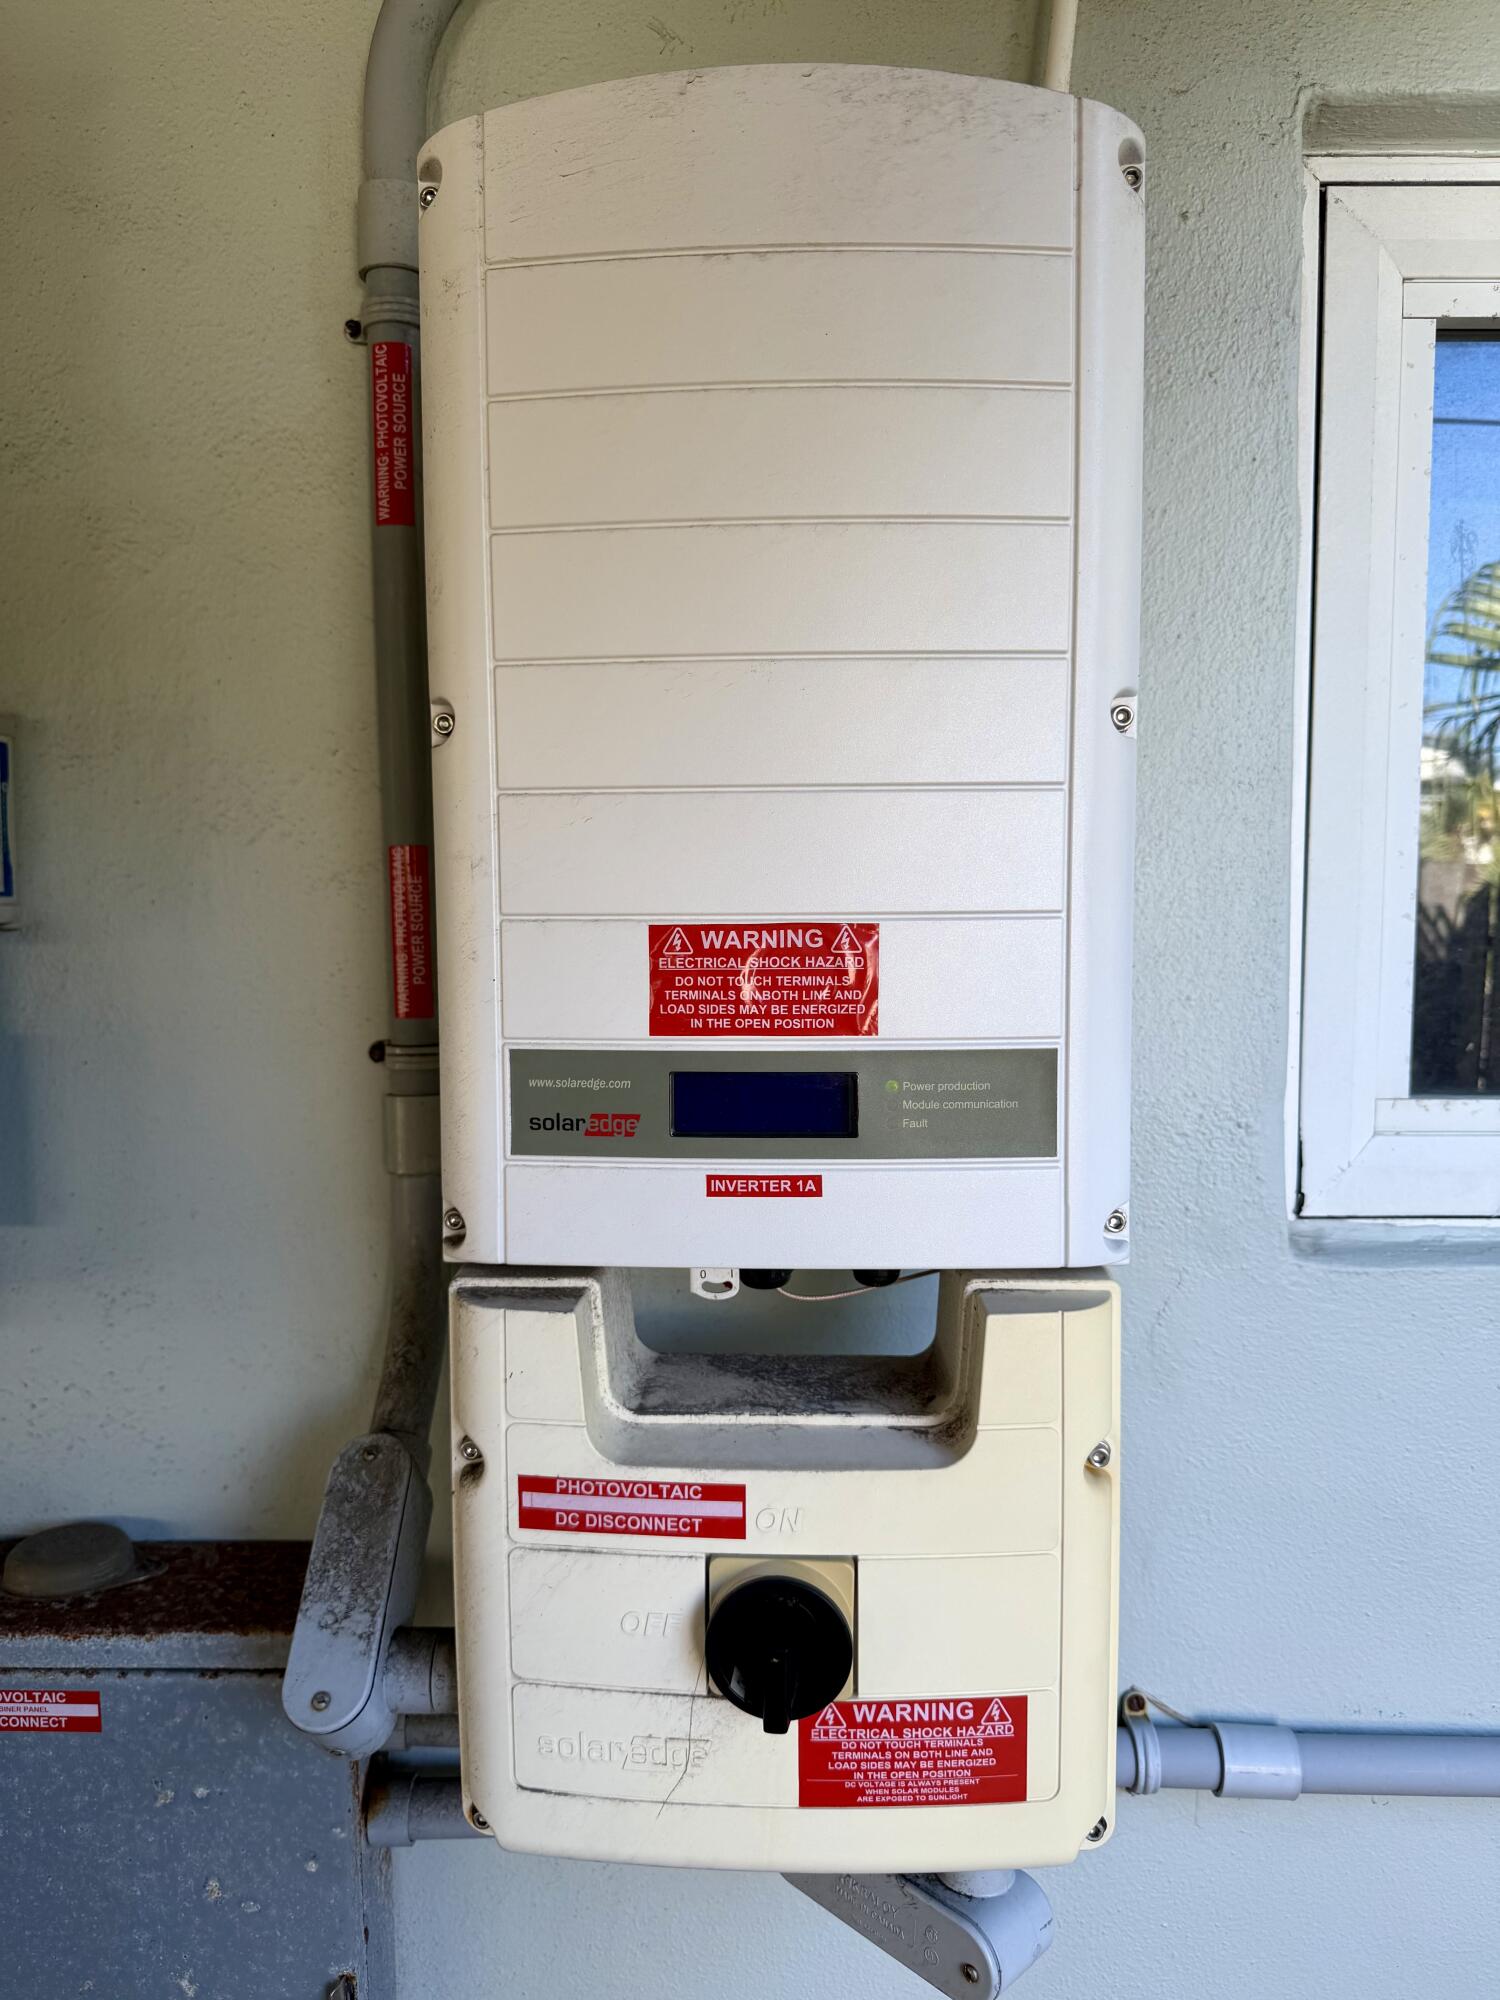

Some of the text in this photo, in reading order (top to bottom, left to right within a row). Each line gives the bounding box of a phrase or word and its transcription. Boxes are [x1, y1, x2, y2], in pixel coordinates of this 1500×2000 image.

[375, 344, 391, 521] WARNING: PHOTOVOLTAIC
[392, 373, 407, 490] POWER SOURCE
[410, 875, 425, 985] POWER SOURCE
[700, 929, 824, 949] WARNING
[658, 956, 864, 969] ELECTRICAL SHOCK HAZARD
[675, 975, 850, 987] DO NOT TOUCH TERMINALS
[665, 990, 862, 1001] TERMINALS ON BOTH LINE AND
[660, 1004, 866, 1015] LOAD SIDES MAY BE ENERGIZED
[690, 1018, 834, 1029] IN THE OPEN POSITION
[528, 1077, 631, 1091] www.solaredge.com
[902, 1081, 991, 1093] Power production
[902, 1099, 1019, 1110] Module communication
[529, 1112, 639, 1136] solaredge
[902, 1118, 928, 1128] Fault
[711, 1179, 816, 1192] INVERTER 1A
[555, 1479, 702, 1500] PHOTOVOLTAIC
[555, 1512, 702, 1533] DC DISCONNECT
[755, 1507, 801, 1533] ON
[620, 1610, 683, 1636] OFF
[0, 1691, 67, 1703] VOLTAIC
[852, 1702, 974, 1723] WARNING
[811, 1725, 1014, 1740] ELECTRICAL SHOCK HAZARD
[841, 1738, 984, 1750] DO NOT TOUCH TERMINALS
[538, 1731, 708, 1770] solaredge
[832, 1748, 993, 1760] TERMINALS ON BOTH LINE AND
[828, 1758, 996, 1770] LOAD SIDES MAY BE ENERGIZED
[853, 1769, 971, 1780] IN THE OPEN POSITION
[844, 1781, 856, 1789] DC
[858, 1780, 896, 1788] VOLTAGE
[907, 1779, 940, 1787] ALWAYS
[943, 1778, 980, 1786] PRESENT
[865, 1786, 960, 1795] WHEN SOLAR MODULES
[875, 1794, 913, 1802] EXPOSED
[928, 1793, 968, 1801] SUNLIGHT
